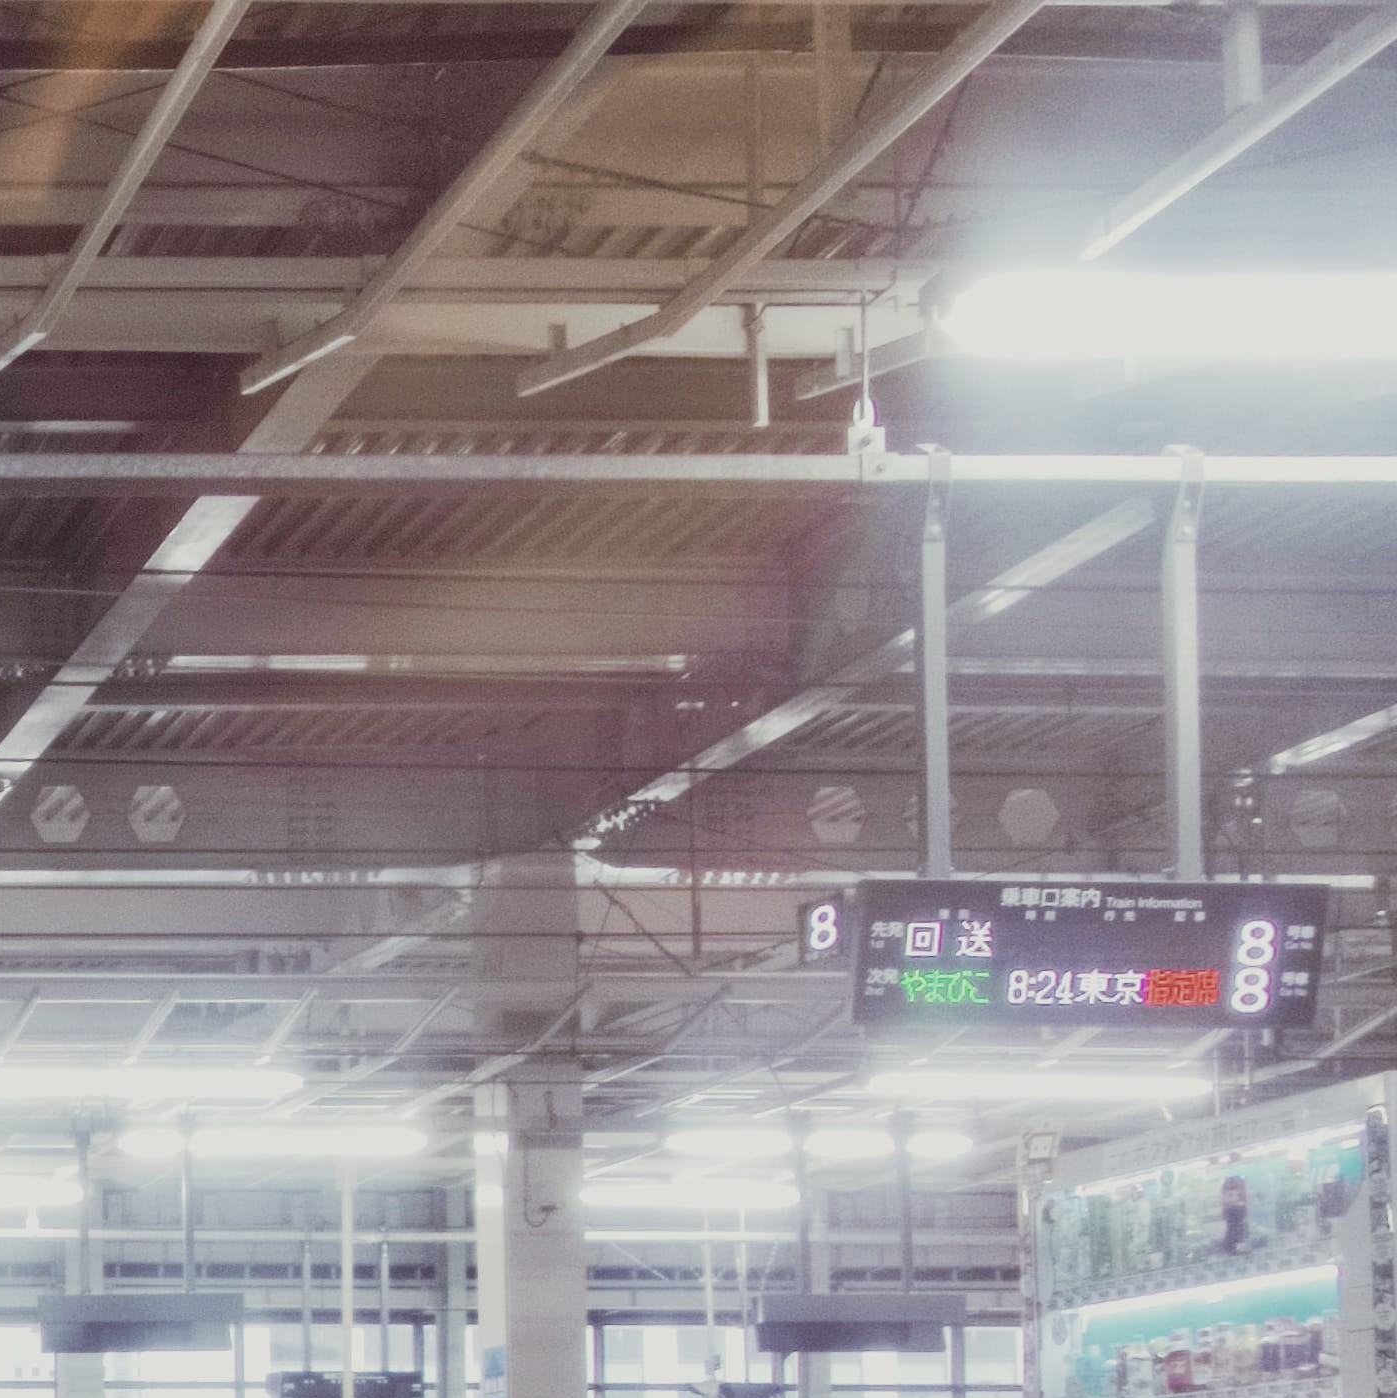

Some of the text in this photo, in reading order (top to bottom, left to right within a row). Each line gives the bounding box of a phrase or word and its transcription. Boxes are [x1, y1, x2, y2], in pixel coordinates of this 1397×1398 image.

[1000, 887, 1202, 909] 乗車口案内 Train Information
[809, 904, 838, 951] 8
[871, 921, 903, 938] 先発
[1236, 919, 1277, 966] 8
[901, 968, 991, 1004] やまびこ
[1007, 969, 1074, 1006] 8:24
[1075, 969, 1145, 1006] 東京
[1230, 966, 1272, 1014] 8
